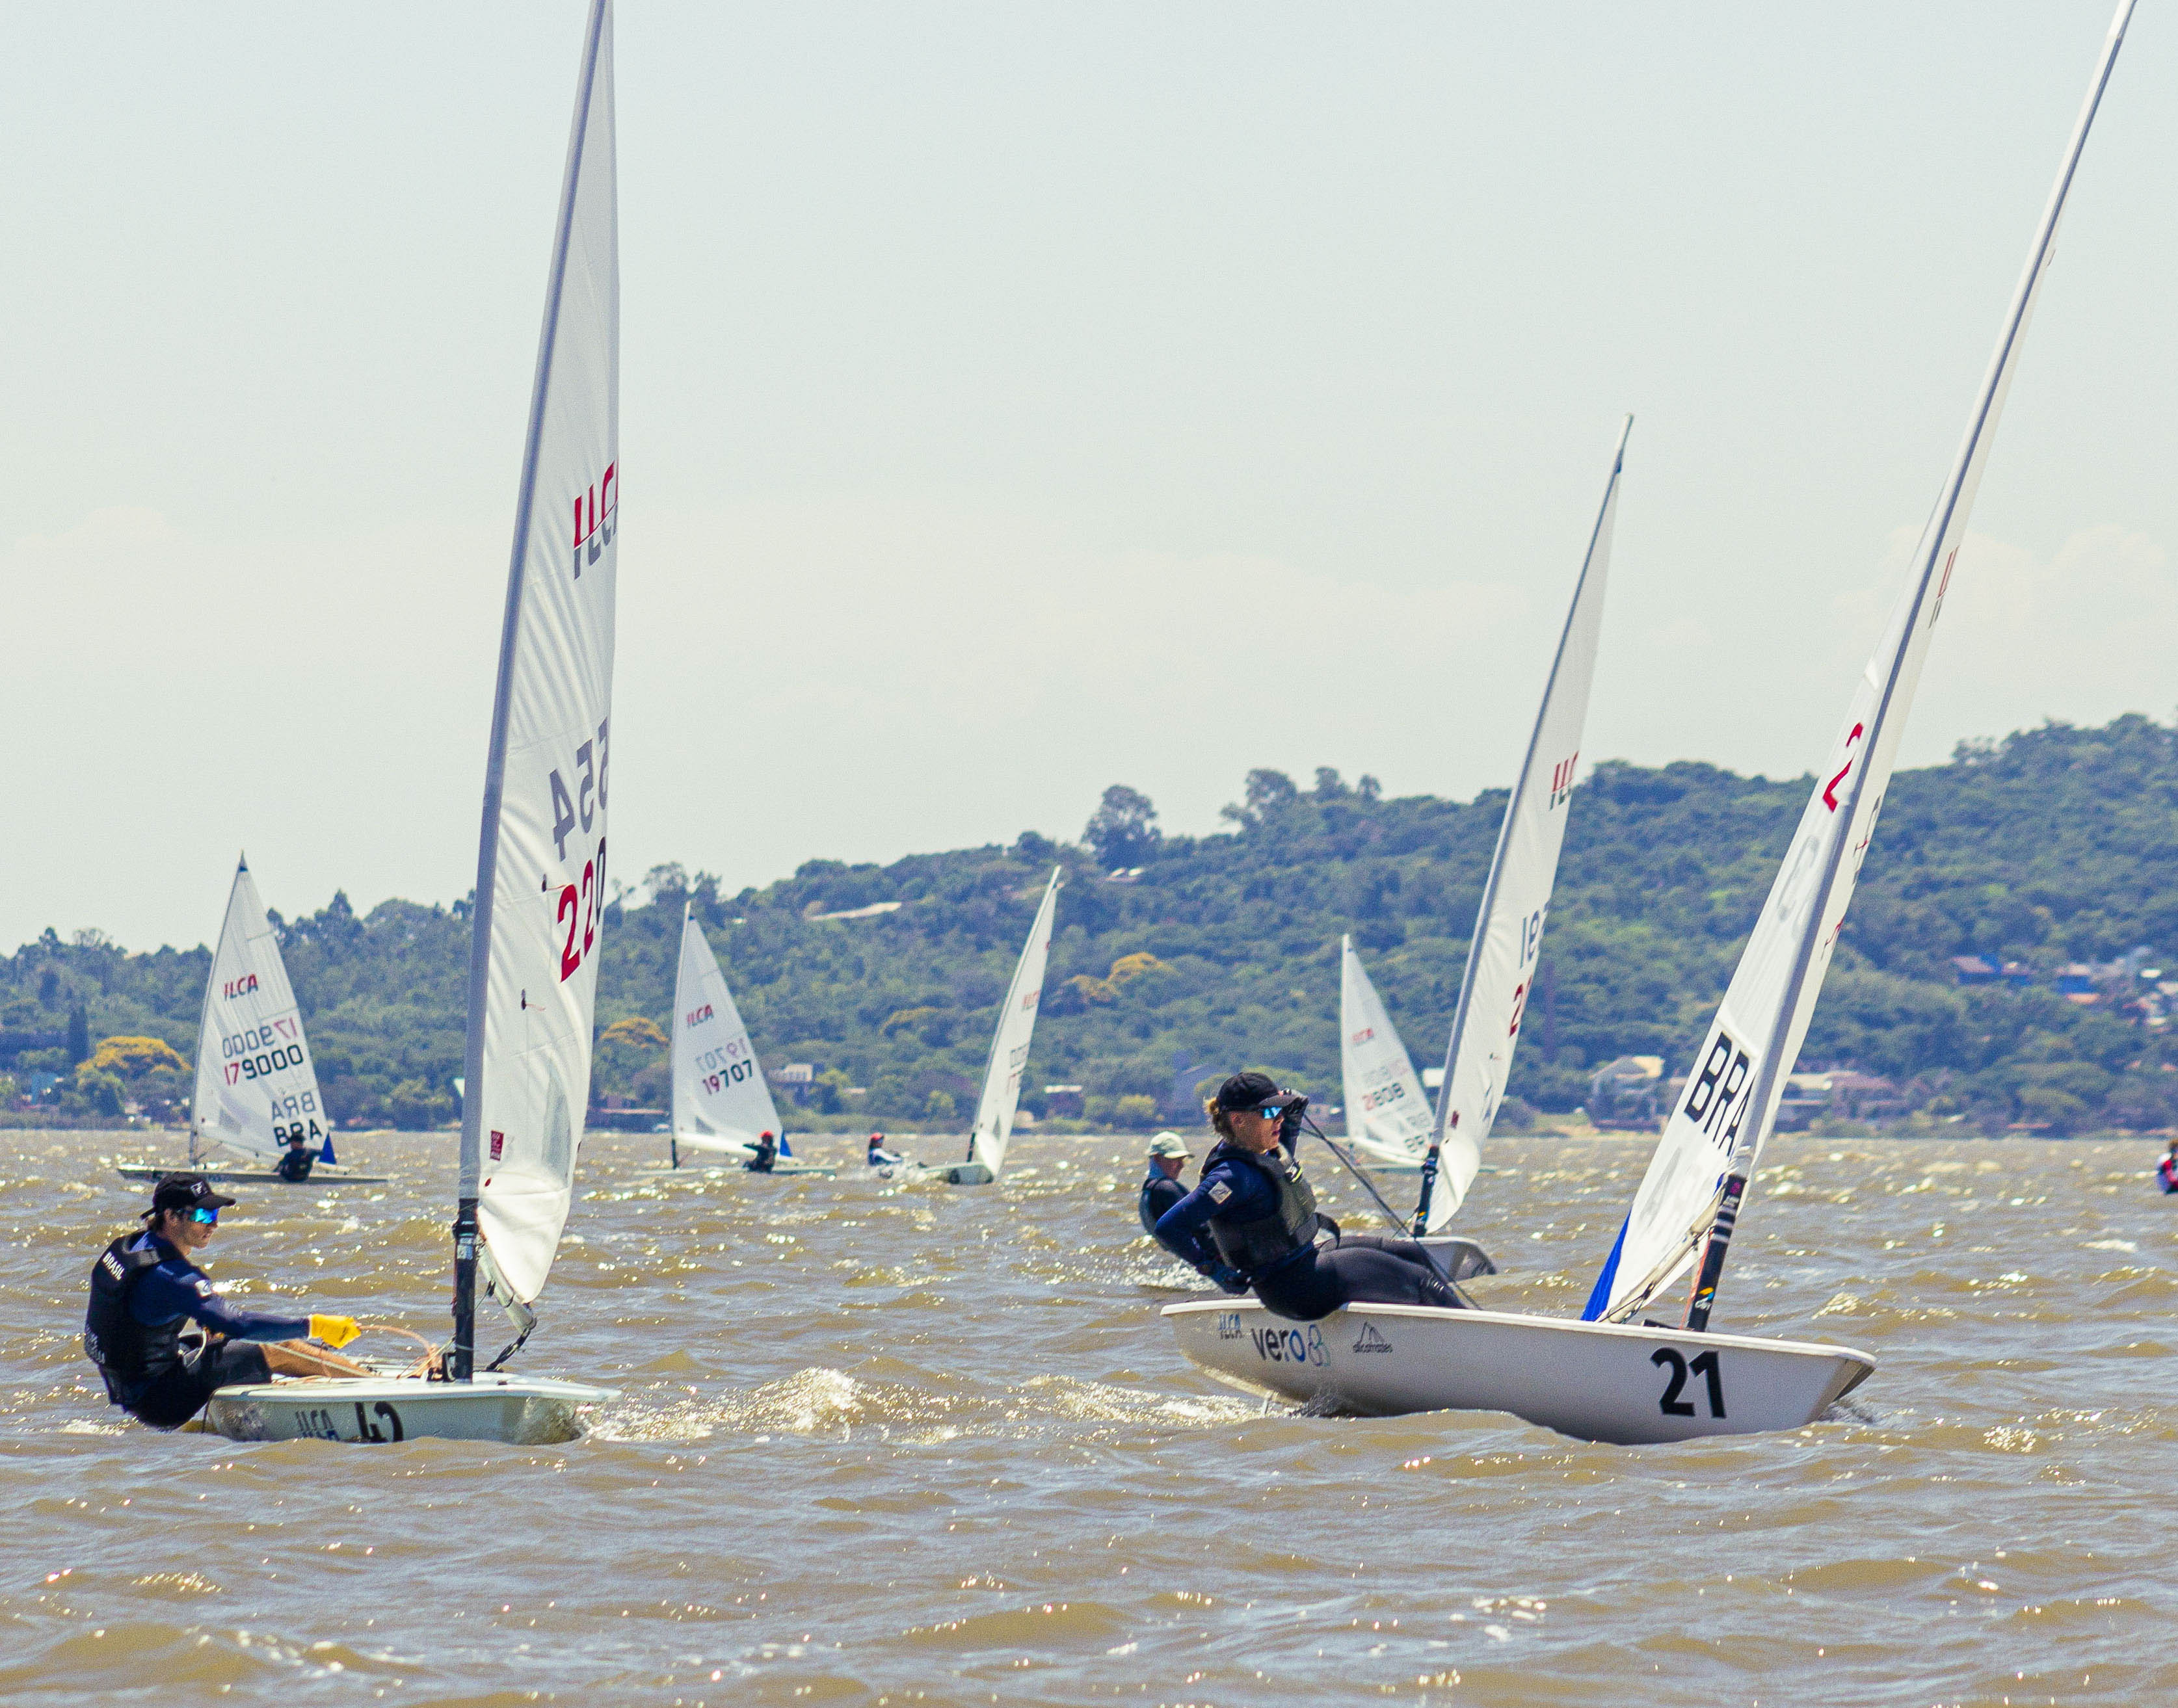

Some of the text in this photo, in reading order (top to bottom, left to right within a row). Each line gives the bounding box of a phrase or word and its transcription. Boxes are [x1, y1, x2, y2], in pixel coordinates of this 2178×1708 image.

[224, 973, 258, 1001] ILCA
[224, 1044, 304, 1086] 179000
[702, 1058, 752, 1095] 19707
[1684, 1031, 1756, 1157] BRA
[103, 1252, 124, 1281] BRASIL
[1650, 1347, 1726, 1419] 21
